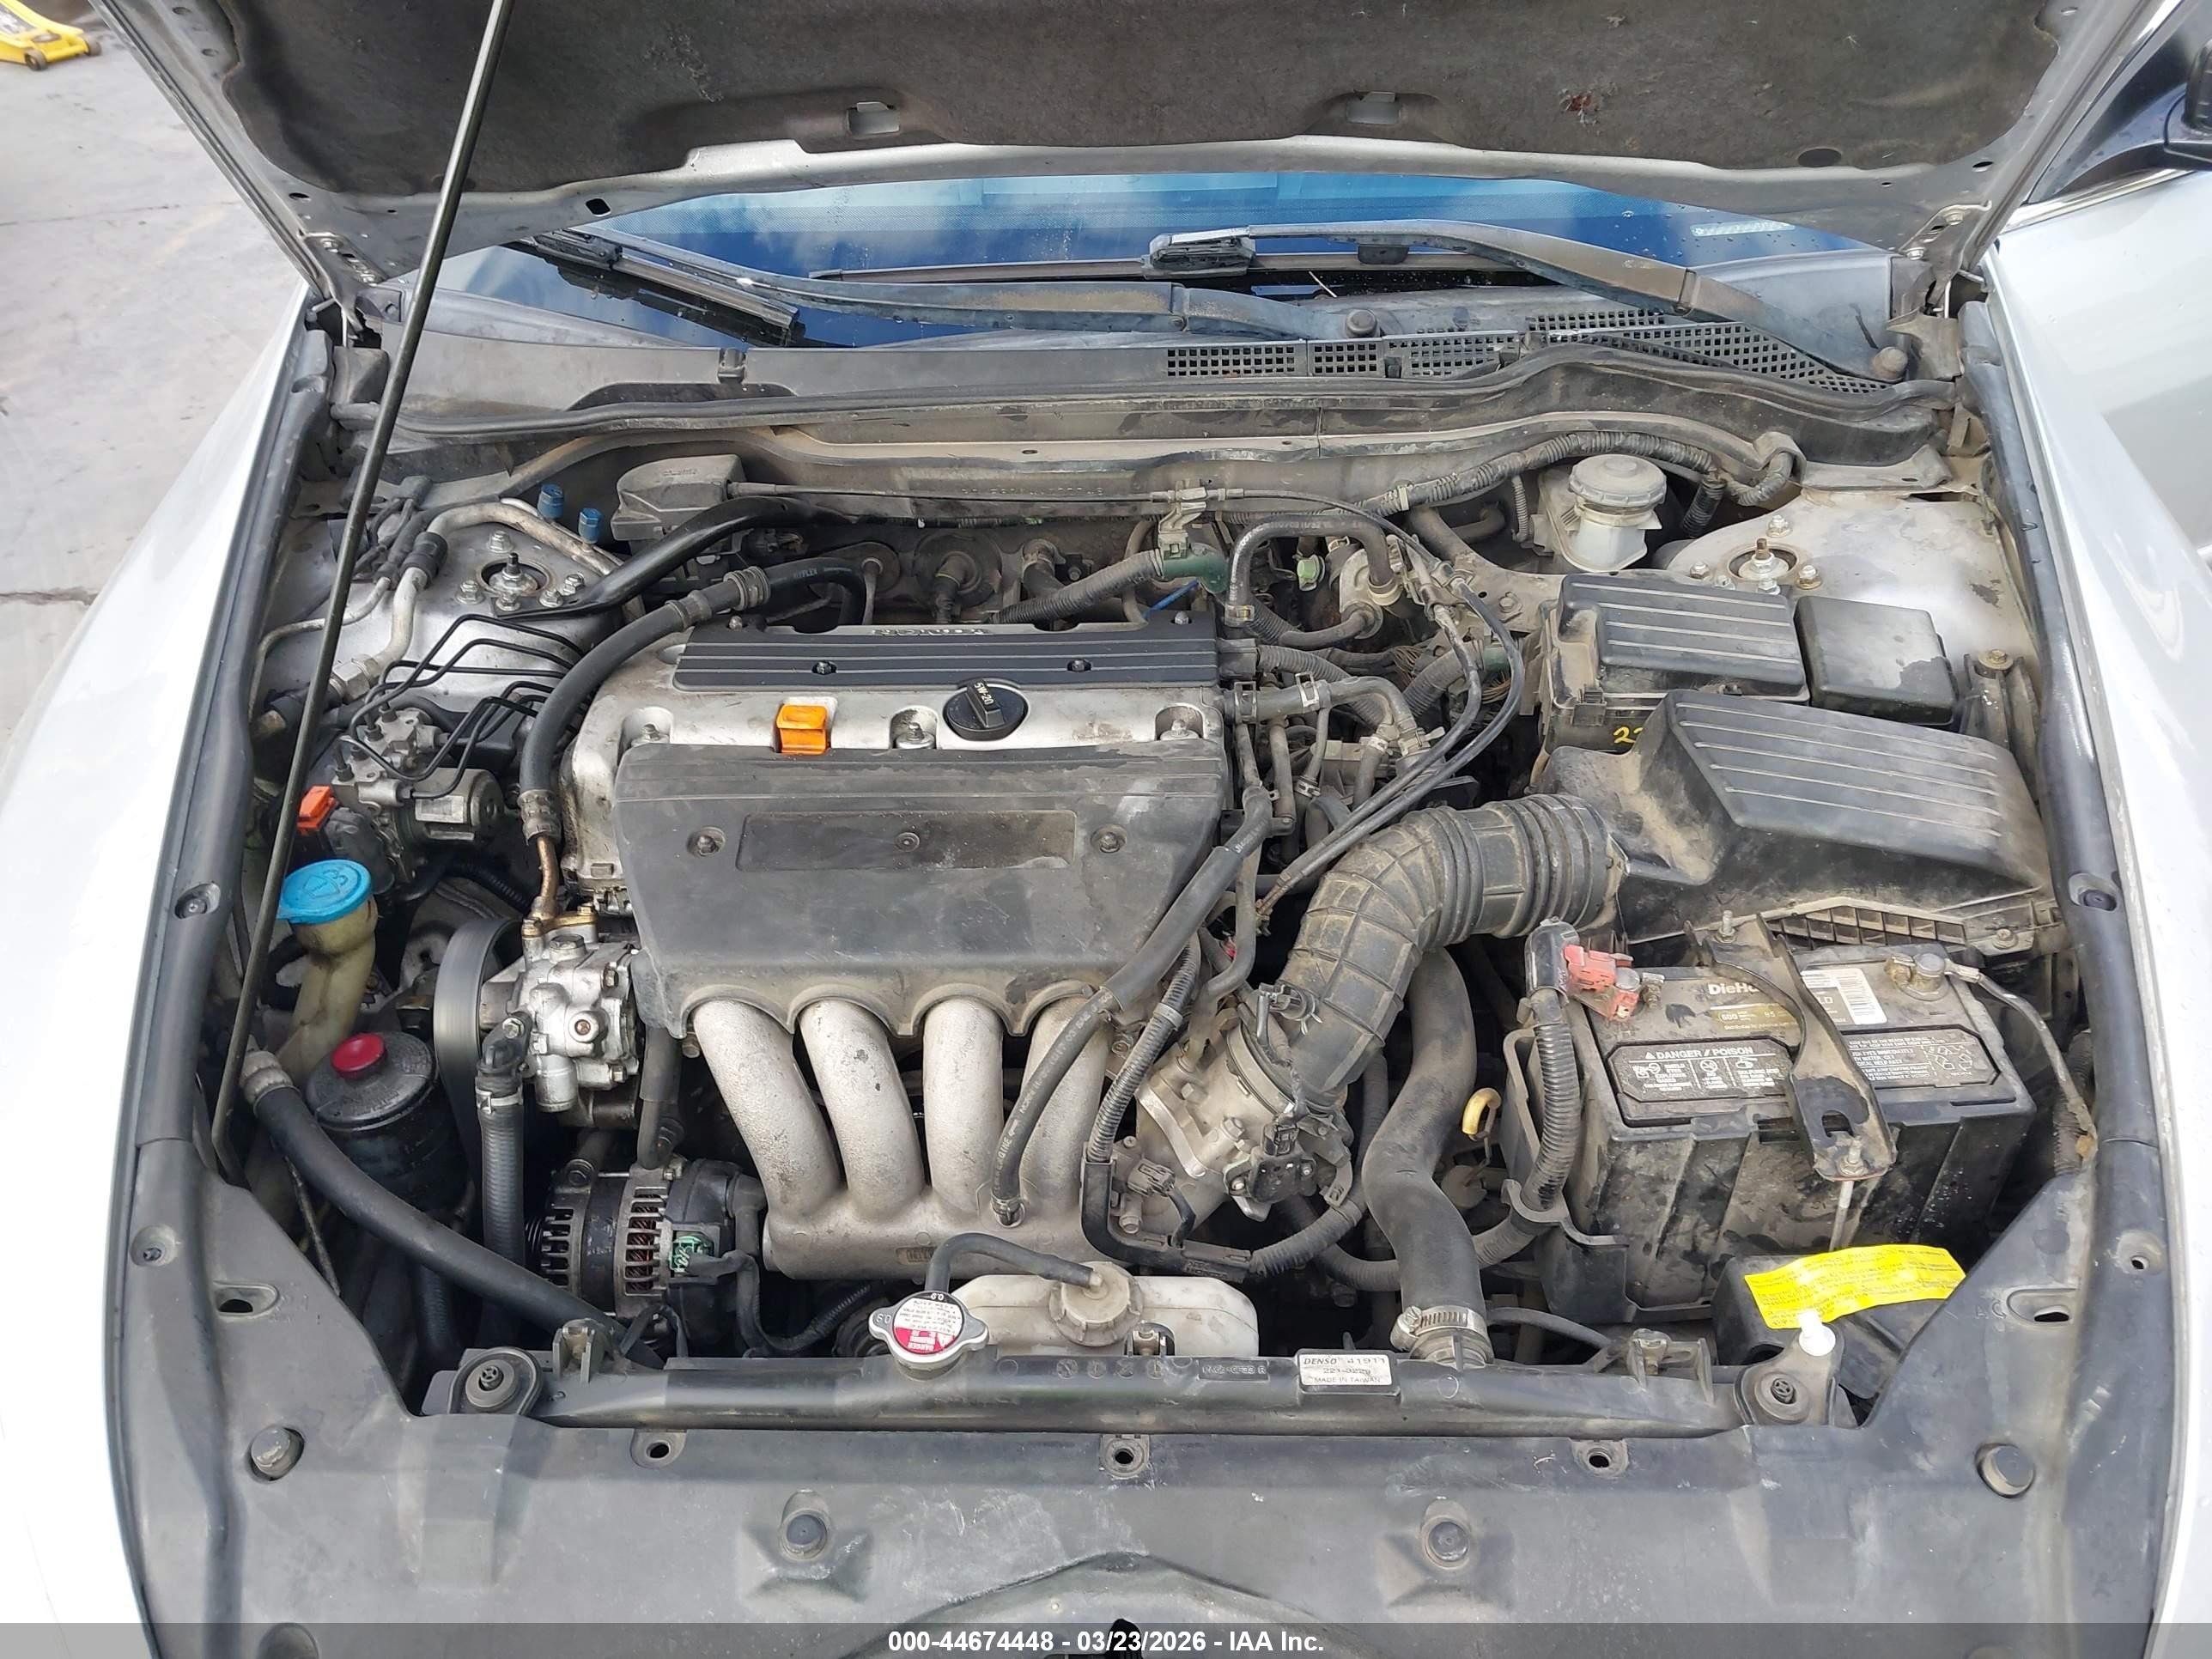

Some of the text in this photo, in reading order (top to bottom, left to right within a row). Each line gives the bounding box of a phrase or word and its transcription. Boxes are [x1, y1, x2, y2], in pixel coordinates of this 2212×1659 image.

[974, 682, 994, 706] 5W-20
[1655, 1050, 1703, 1060] DANGER
[1712, 1047, 1753, 1056] POISON
